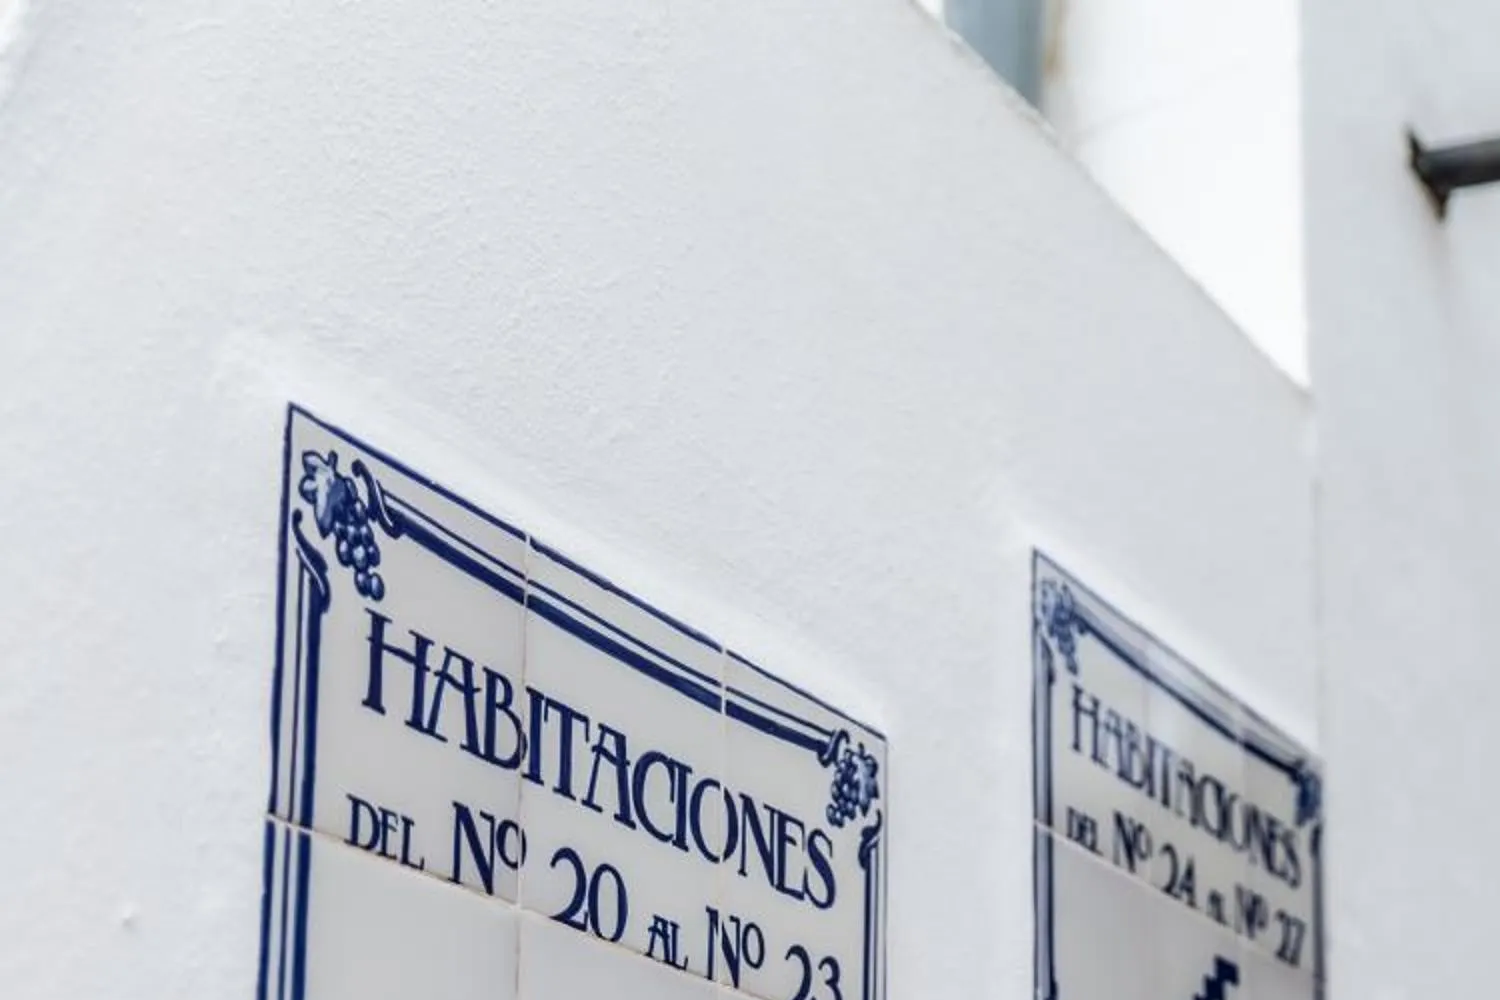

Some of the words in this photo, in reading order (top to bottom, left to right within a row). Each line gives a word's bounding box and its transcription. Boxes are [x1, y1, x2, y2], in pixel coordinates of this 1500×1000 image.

[362, 607, 837, 910] HABITACIONES
[1072, 683, 1302, 889] HABITACIONES
[344, 793, 425, 871] DEL
[549, 846, 629, 943] 20
[644, 914, 689, 971] AL
[1066, 805, 1103, 857] DEL
[1157, 842, 1199, 909] 24
[1275, 908, 1308, 969] 27
